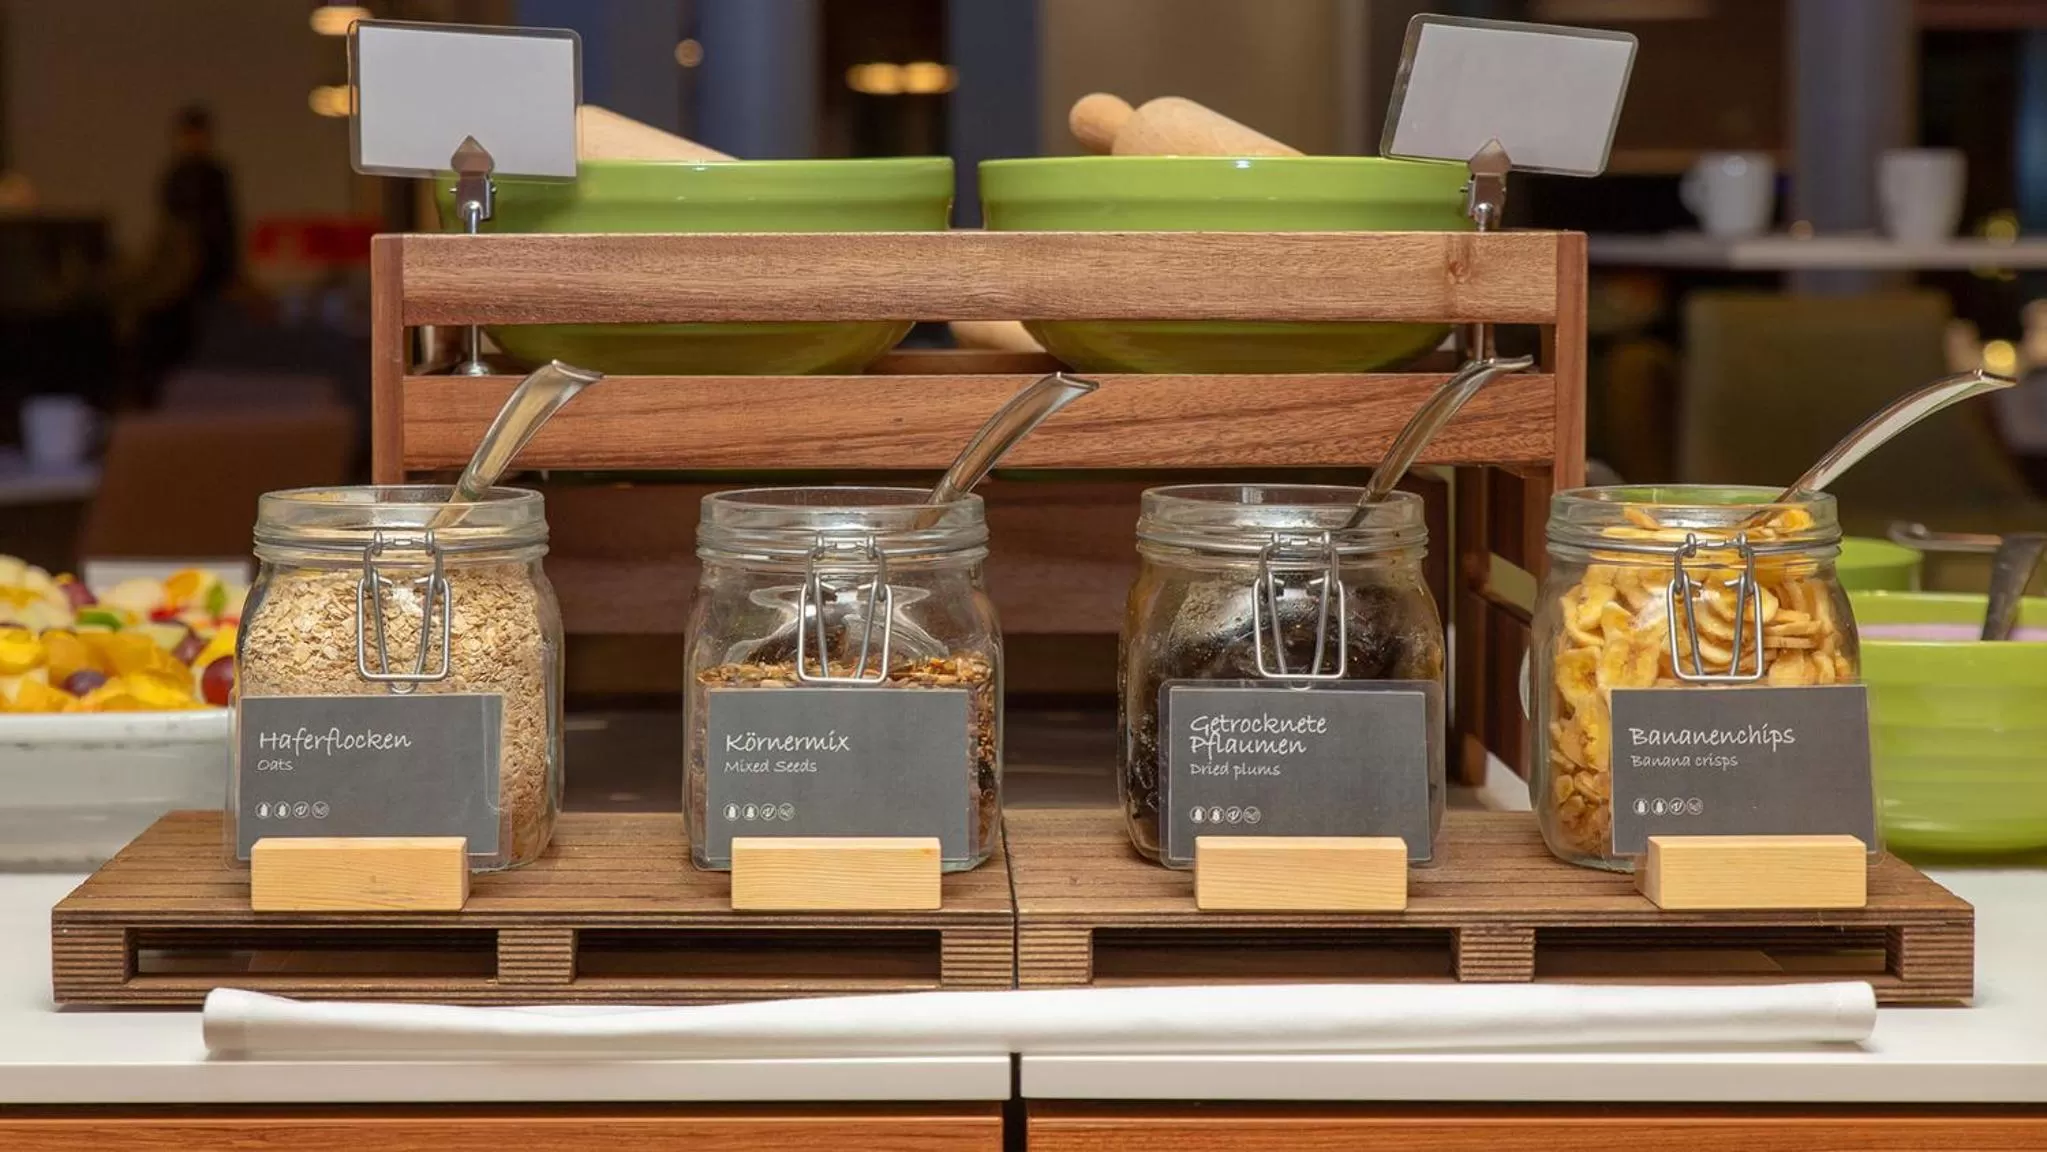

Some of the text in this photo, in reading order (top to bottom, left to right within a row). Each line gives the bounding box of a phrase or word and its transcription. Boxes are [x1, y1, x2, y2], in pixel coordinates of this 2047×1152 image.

[1190, 713, 1327, 735] Getrocknete
[259, 727, 412, 756] Haferflocken
[725, 730, 850, 752] Körnermix
[1189, 733, 1307, 760] Pflaumen
[1628, 723, 1796, 752] Bananenchips
[257, 758, 294, 771] Oats
[724, 758, 817, 773] Mixed Seeds
[1190, 761, 1281, 780] Dried plums
[1630, 754, 1738, 771] Banana crisps
